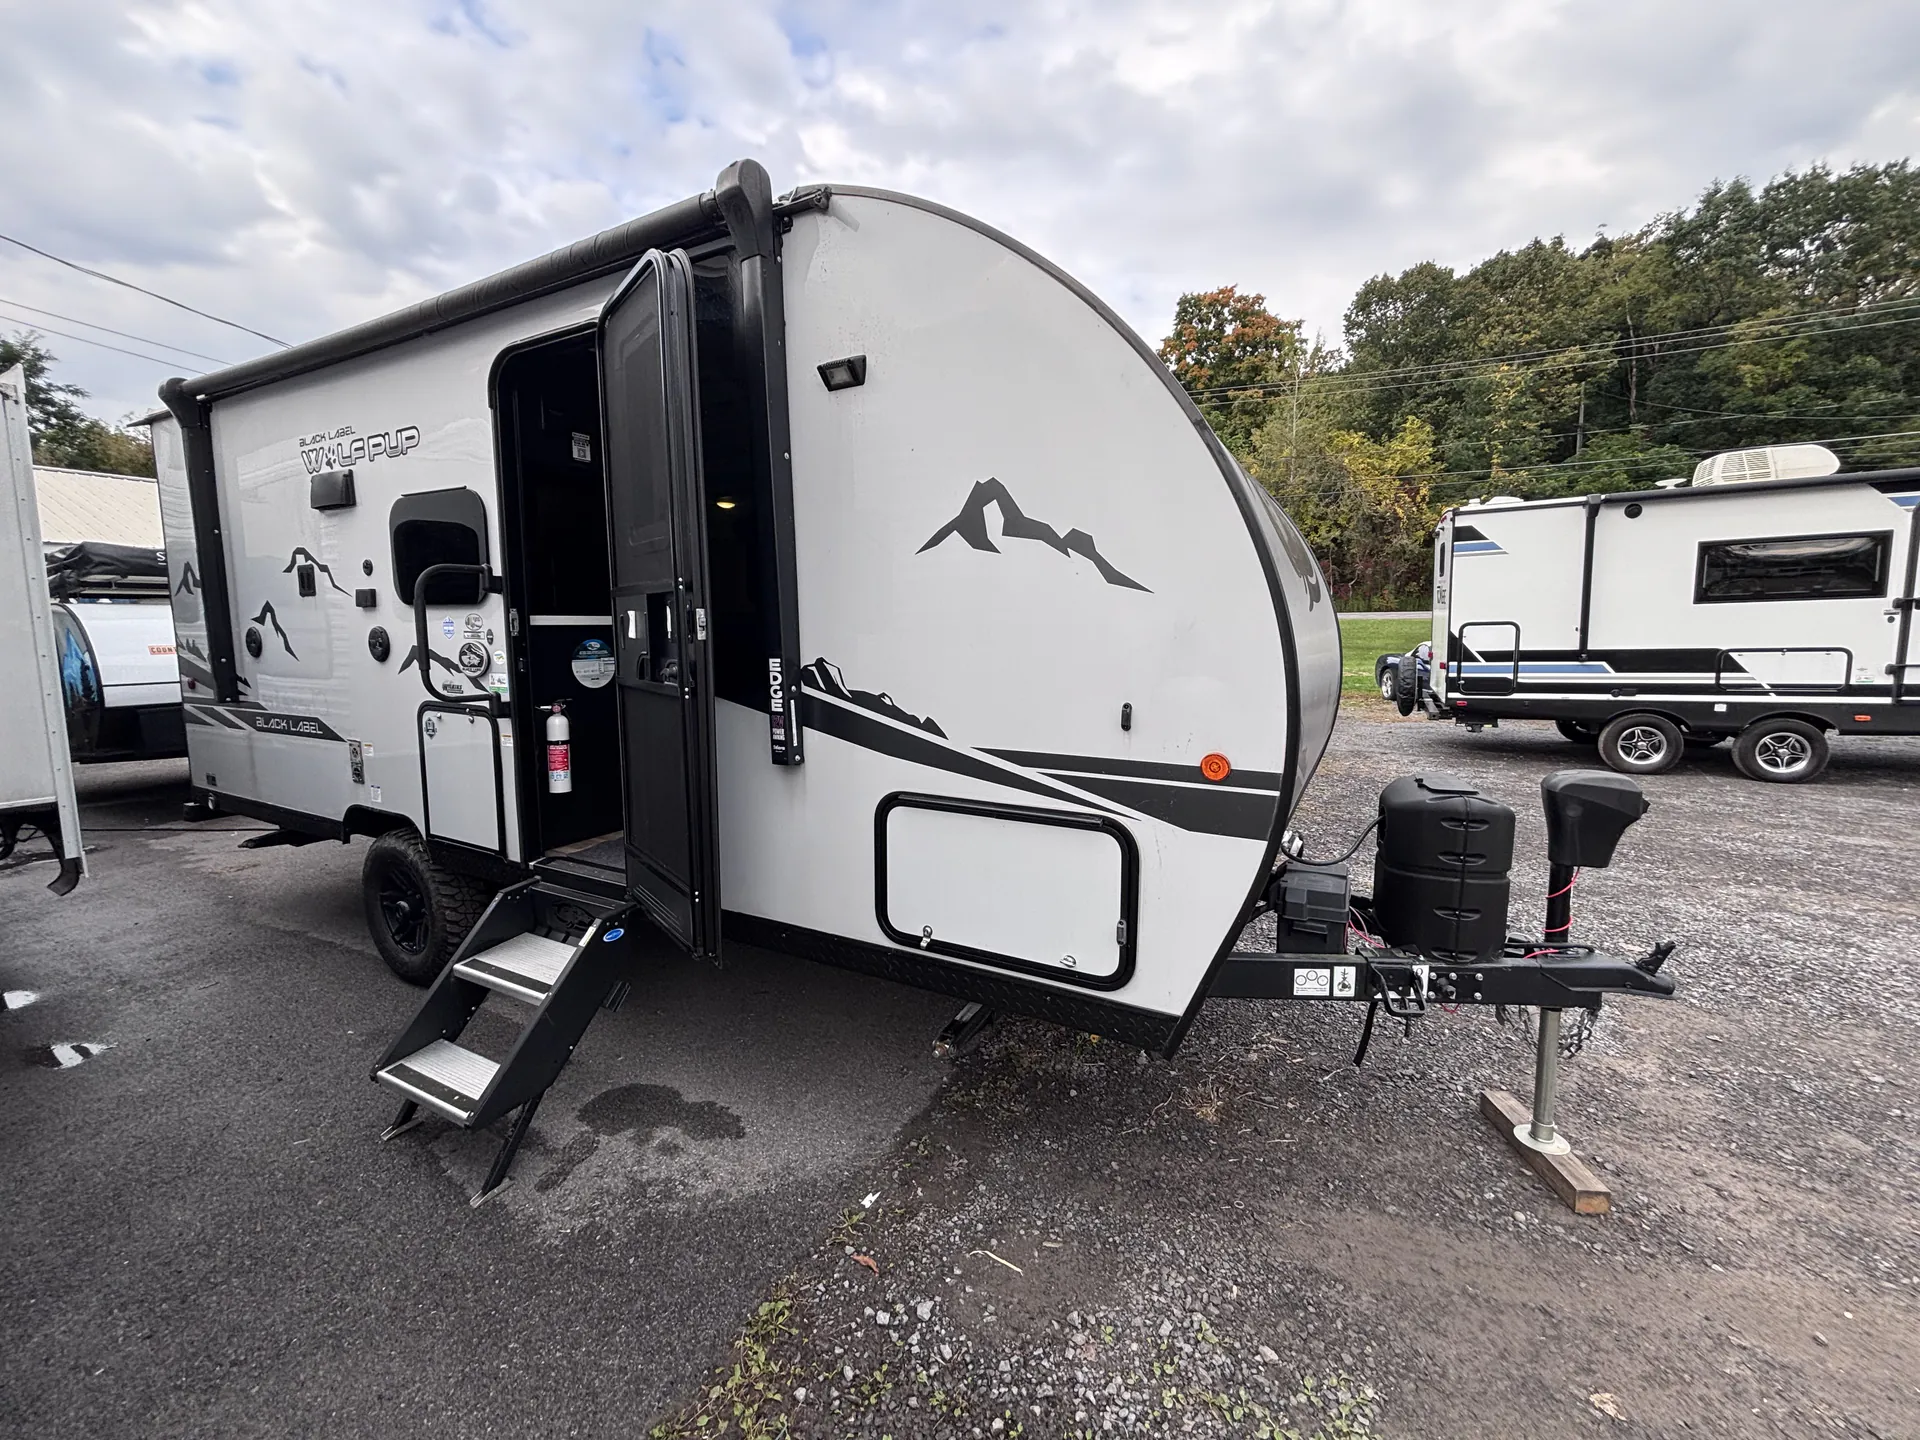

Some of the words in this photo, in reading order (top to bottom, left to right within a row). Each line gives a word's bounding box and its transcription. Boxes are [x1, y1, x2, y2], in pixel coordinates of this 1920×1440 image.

[299, 433, 326, 447] BLACK
[328, 426, 356, 440] LABEL
[367, 426, 420, 462] PUP
[769, 658, 783, 712] EDGE
[256, 716, 288, 730] BLACK
[289, 720, 323, 734] LABEL
